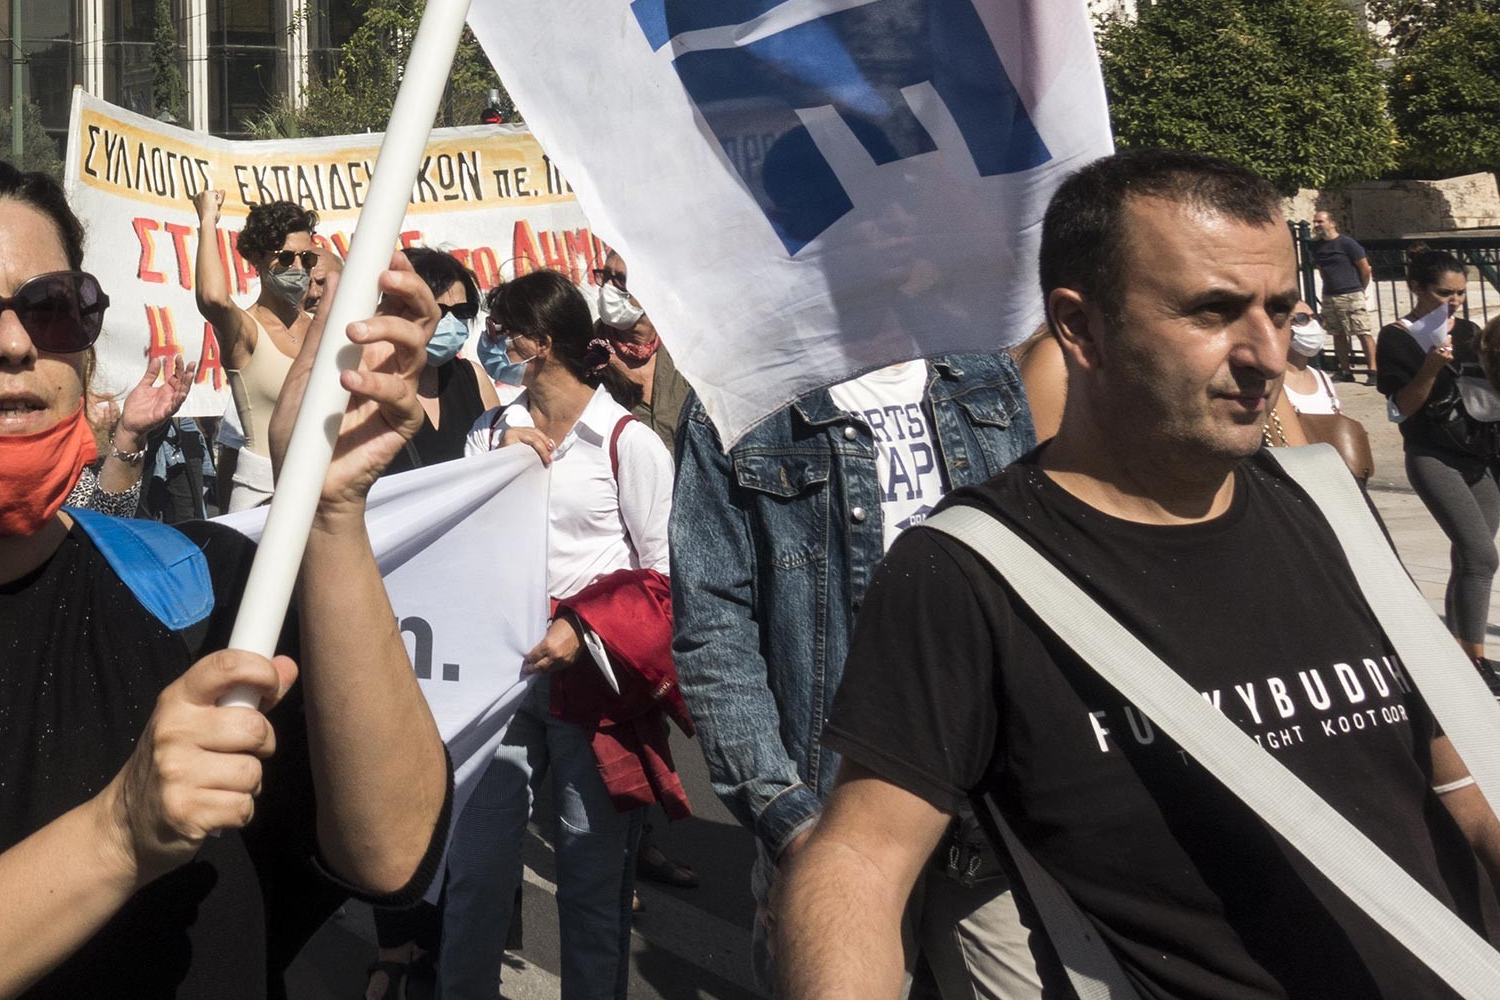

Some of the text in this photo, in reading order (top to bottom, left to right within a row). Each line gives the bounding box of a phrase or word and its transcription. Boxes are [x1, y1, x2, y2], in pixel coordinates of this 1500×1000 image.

[85, 125, 210, 200] ΣΥΛΛΟΓΟΣ
[235, 151, 482, 210] ΕΚΠΑΙΔΕΚΩΝ
[850, 403, 925, 442] RTS
